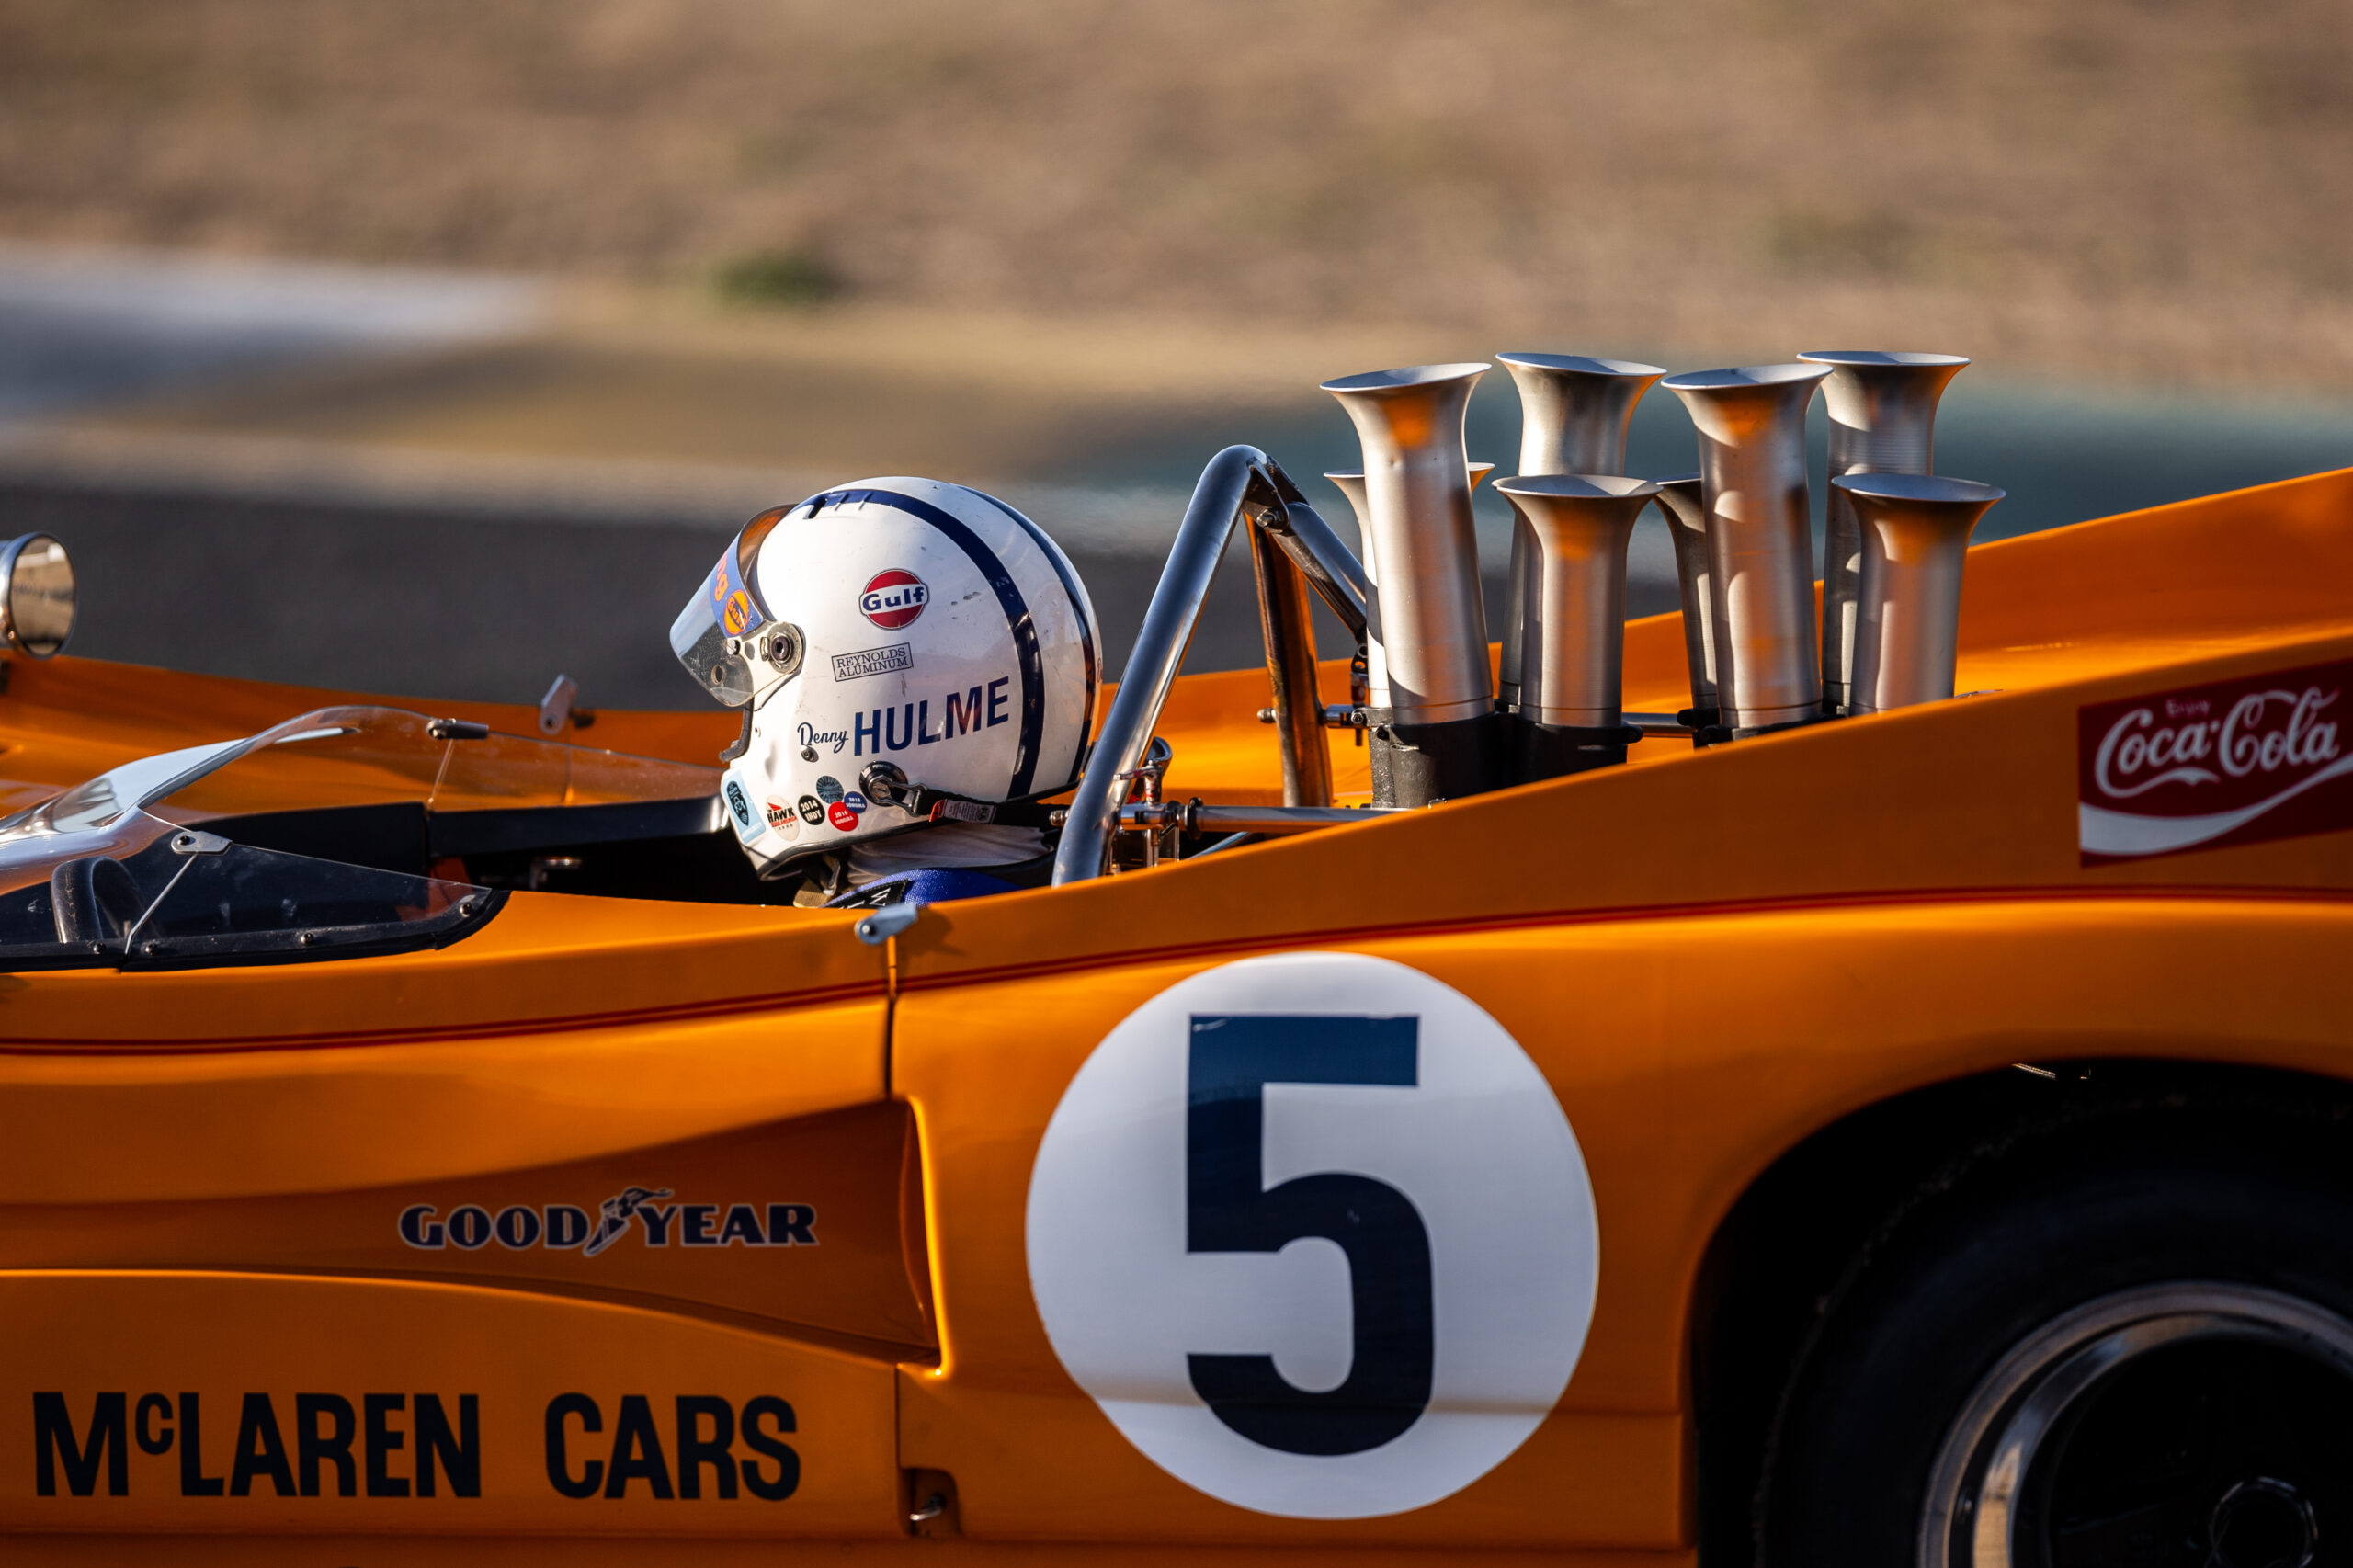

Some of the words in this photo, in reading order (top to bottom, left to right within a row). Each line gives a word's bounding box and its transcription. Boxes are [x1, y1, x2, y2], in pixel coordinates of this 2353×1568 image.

[862, 586, 925, 612] Gulf
[836, 647, 906, 668] REYNOLDS
[838, 656, 909, 678] ALUMINUM
[797, 722, 849, 754] Denny
[854, 676, 1009, 756] HULME
[2095, 686, 2341, 799] Coca-Cola
[767, 807, 796, 824] HAWK
[800, 800, 819, 812] 2014
[804, 810, 823, 823] INDY
[1186, 1013, 1436, 1458] 5
[544, 1392, 802, 1501] CARS
